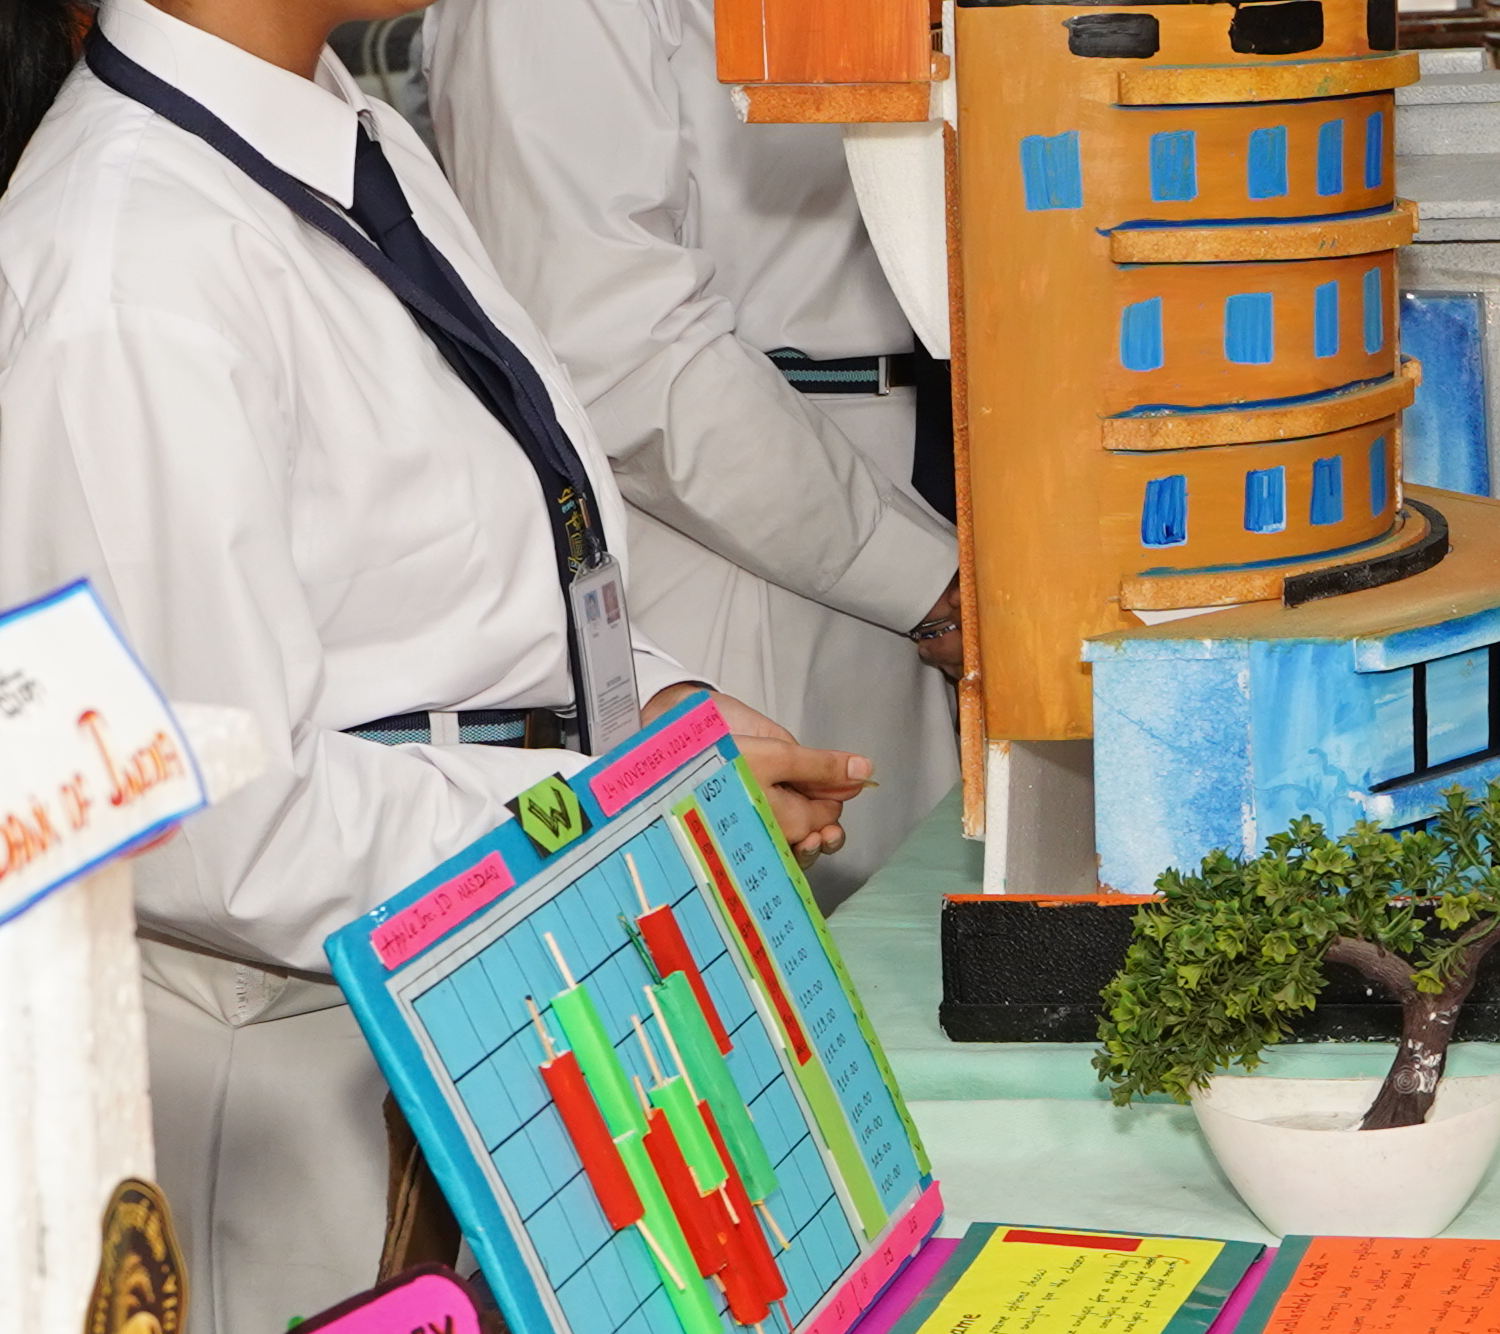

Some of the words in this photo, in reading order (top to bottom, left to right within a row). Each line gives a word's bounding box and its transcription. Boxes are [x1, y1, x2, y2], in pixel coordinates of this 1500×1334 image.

[618, 749, 666, 792] NOVEMBER
[527, 786, 572, 839] W
[457, 864, 500, 902] NASDAQ
